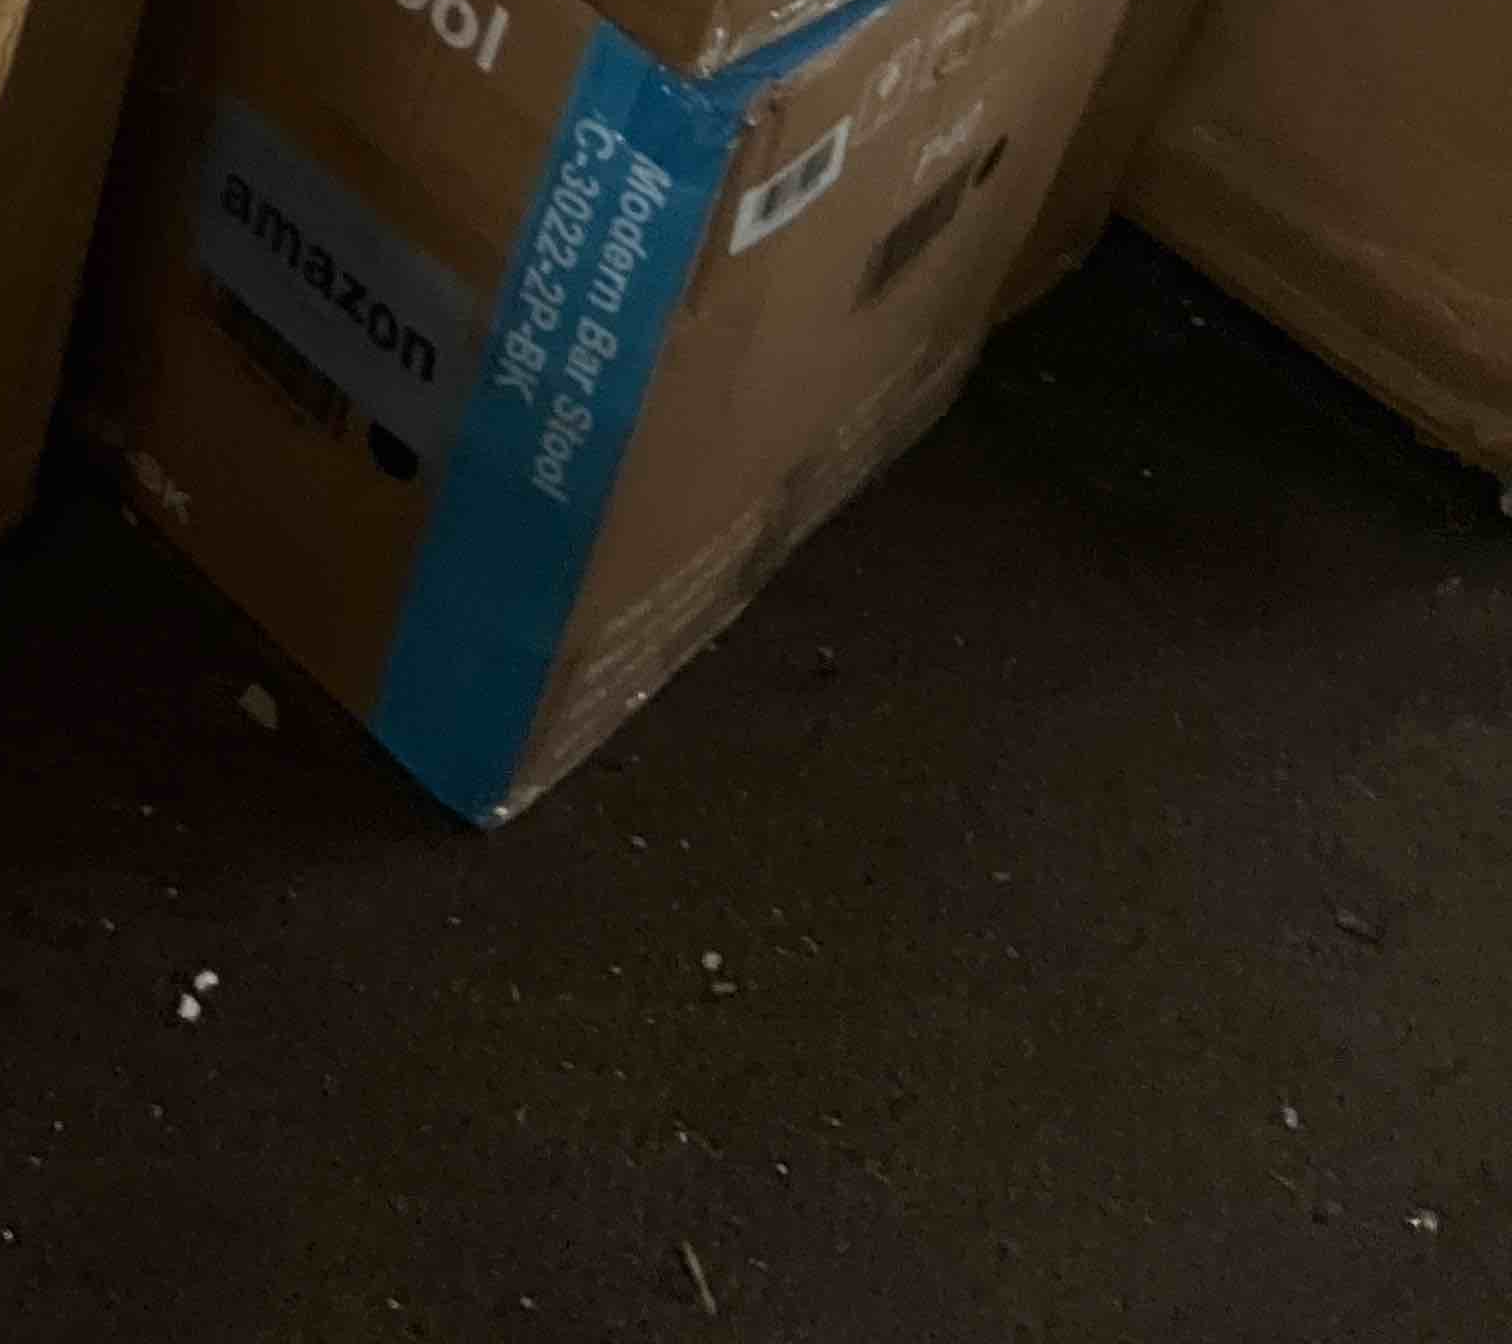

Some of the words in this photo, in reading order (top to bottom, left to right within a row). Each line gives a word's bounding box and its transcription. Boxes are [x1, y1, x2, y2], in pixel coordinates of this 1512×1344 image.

[219, 174, 440, 385] amazon
[496, 118, 617, 404] C-3022-2P-BK
[587, 151, 672, 314] Modern
[567, 324, 617, 396] Bar
[531, 404, 594, 503] Stool
